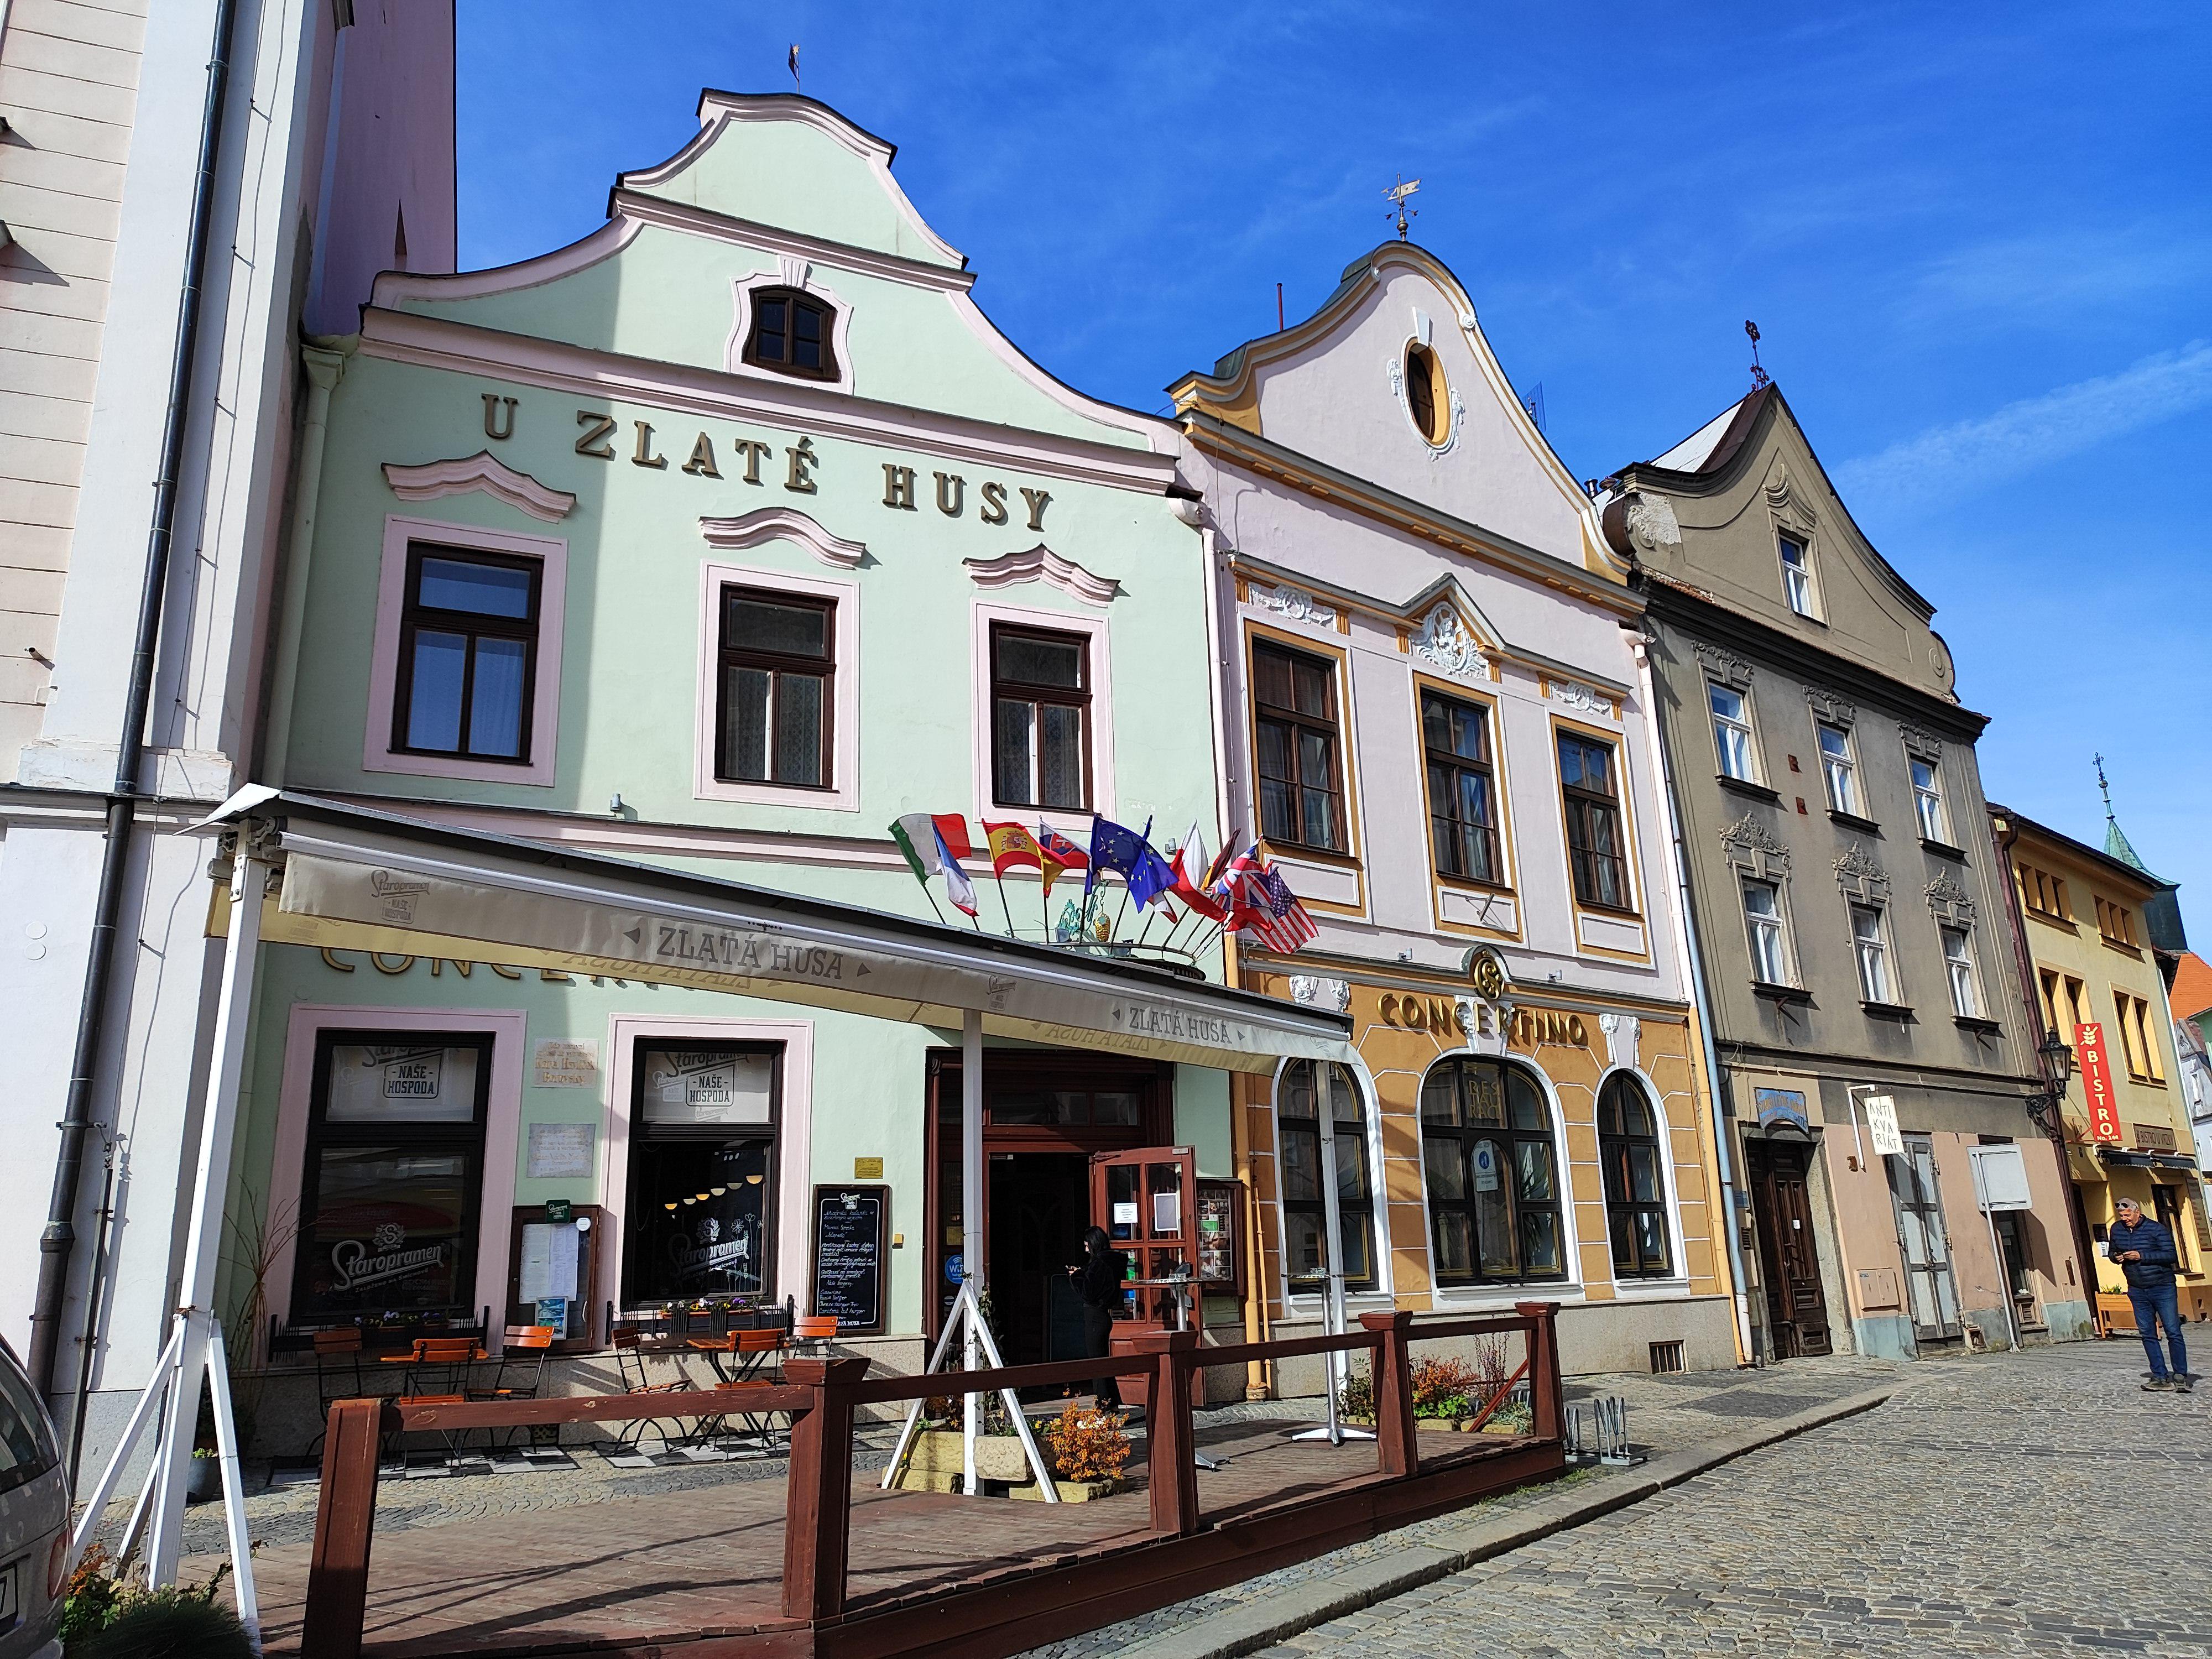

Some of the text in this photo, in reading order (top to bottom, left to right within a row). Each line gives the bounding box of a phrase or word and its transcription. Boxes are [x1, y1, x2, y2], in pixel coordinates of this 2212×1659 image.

[481, 393, 1049, 530] U ZLATÉ HUSY
[657, 926, 761, 969] ZLATÁ
[770, 942, 843, 979] HUSA
[1129, 1007, 1232, 1044] ZLATÁ HUSA
[1377, 993, 1582, 1043] CONCERTINO
[387, 1081, 435, 1095] HOSPODA
[399, 1063, 427, 1079] NAŠE
[698, 1074, 722, 1088] NAŠE
[690, 1090, 730, 1103] HOSPODA
[1870, 1103, 1891, 1119] ANTI
[2086, 1050, 2114, 1135] BISTRO
[332, 1240, 444, 1291] Staropramen
